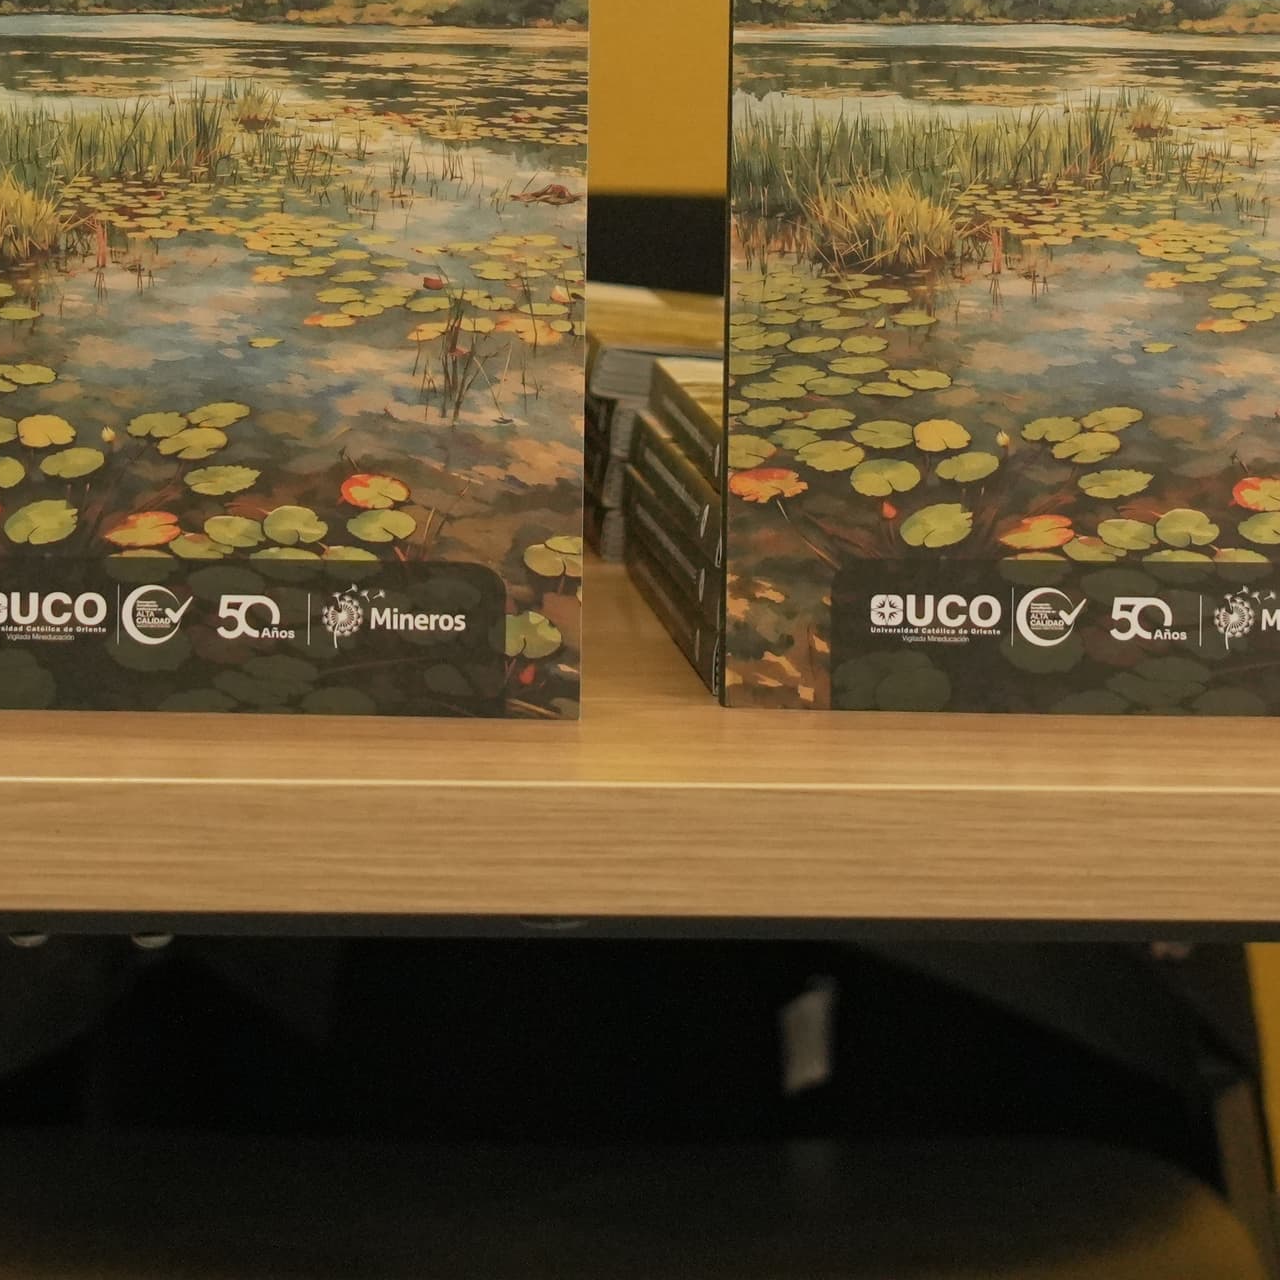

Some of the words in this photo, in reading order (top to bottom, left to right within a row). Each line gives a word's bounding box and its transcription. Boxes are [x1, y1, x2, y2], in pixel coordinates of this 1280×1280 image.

[10, 591, 107, 626] UCO
[217, 594, 281, 639] 50
[370, 607, 466, 632] Mineros
[906, 594, 1002, 628] UCO
[1109, 595, 1173, 641] 50
[261, 626, 296, 640] Años
[1153, 627, 1188, 641] Años
